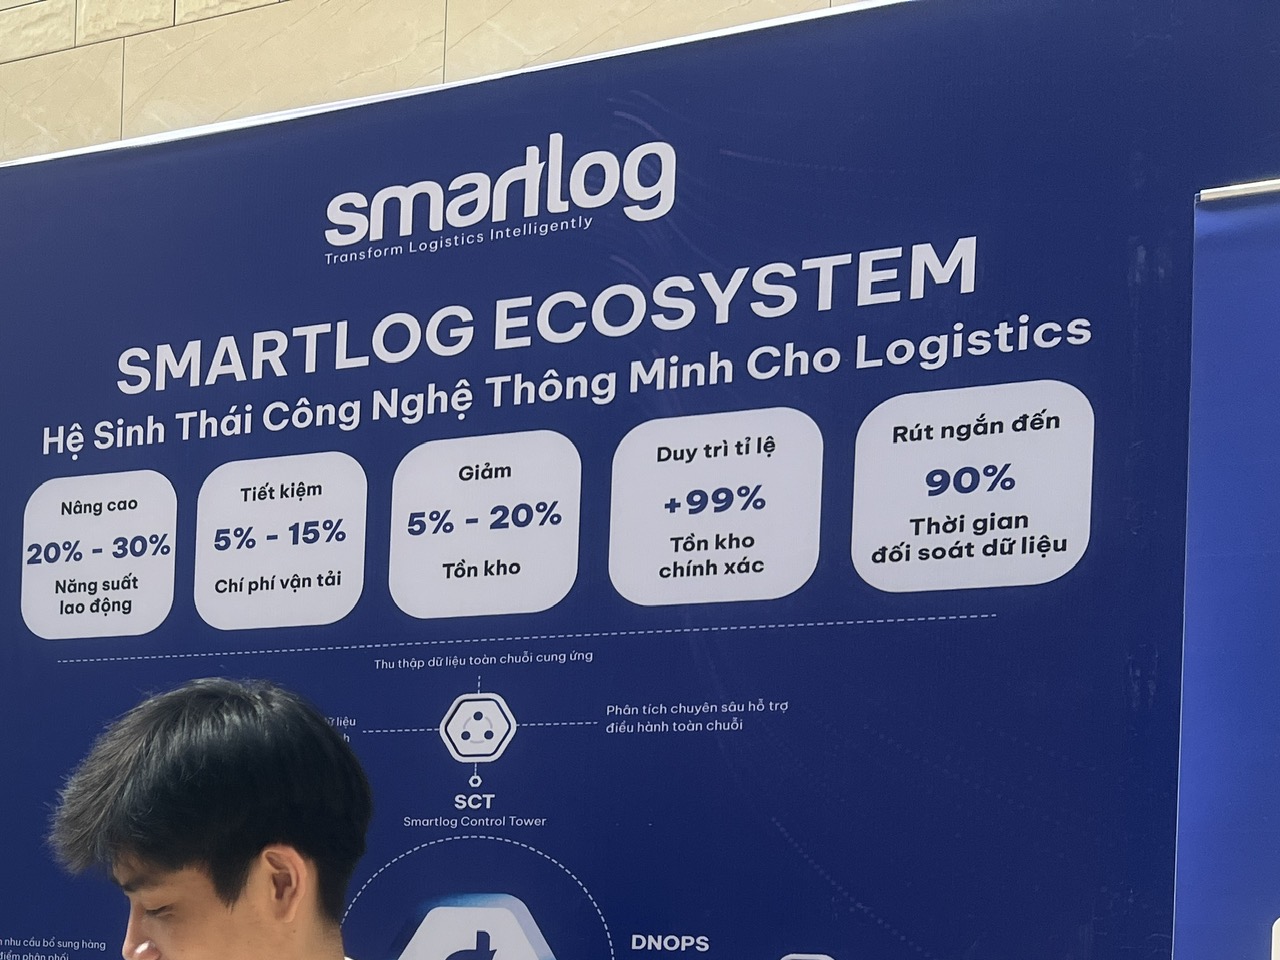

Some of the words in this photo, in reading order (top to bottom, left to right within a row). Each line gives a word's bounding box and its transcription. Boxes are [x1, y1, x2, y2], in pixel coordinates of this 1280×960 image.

[325, 133, 676, 248] smartlog
[325, 246, 403, 264] Transform
[409, 233, 484, 253] Logistics
[490, 216, 593, 240] Intelligently
[117, 306, 474, 394] SMARTLOG
[495, 236, 976, 357] ECOSYSTEM
[43, 423, 84, 460] Hệ
[94, 415, 164, 449] Sinh
[175, 404, 252, 440] Thái
[263, 397, 360, 431] Công
[372, 379, 473, 424] Nghệ
[485, 369, 616, 407] Thông
[630, 351, 733, 393] Minh
[747, 342, 840, 379] Cho
[856, 314, 1091, 370] Logistics
[893, 423, 934, 443] Rút
[941, 413, 1004, 441] ngắn
[1012, 409, 1060, 432] đến
[657, 447, 698, 464] Duy
[703, 439, 728, 458] trì
[735, 436, 751, 455] tỉ
[757, 436, 775, 458] lệ
[459, 462, 511, 481] Giảm
[926, 463, 1015, 496] 90%
[240, 482, 275, 502] Tiết
[280, 481, 322, 502] kiệm
[664, 485, 766, 515] +99%
[61, 500, 102, 516] Nâng
[107, 499, 138, 511] cao
[407, 509, 454, 536] 5%
[490, 501, 562, 530] 20%
[214, 526, 256, 551] 5%
[288, 518, 346, 545] 15%
[909, 514, 965, 536] Thời
[973, 512, 1028, 536] gian
[27, 540, 83, 565] 20%
[112, 533, 170, 558] 30%
[670, 533, 708, 552] Tồn
[715, 533, 755, 550] kho
[871, 541, 911, 563] đối
[918, 540, 974, 561] soát
[1021, 535, 1067, 558] liệu
[442, 559, 478, 579] Tồn
[484, 559, 521, 576] kho
[659, 559, 717, 578] chính
[724, 556, 764, 575] xác
[55, 579, 97, 595] Năng
[102, 572, 138, 591] suất
[215, 577, 244, 593] Chí
[248, 575, 276, 595] phí
[280, 574, 311, 593] vận
[316, 570, 341, 587] tải
[60, 600, 85, 615] lao
[90, 597, 132, 617] động
[374, 659, 395, 669] Thu
[398, 658, 425, 669] thập
[445, 655, 466, 668] liệu
[469, 654, 496, 665] toàn
[536, 652, 566, 665] cung
[607, 704, 638, 716] Phân
[642, 704, 667, 715] tích
[670, 702, 717, 716] chuyên
[721, 701, 744, 712] sâu
[769, 701, 788, 713] trợ
[637, 721, 669, 732] hành
[673, 720, 703, 732] toàn
[454, 794, 495, 809] SCT
[404, 816, 458, 829] Smartlog
[461, 816, 505, 826] Control
[509, 816, 547, 826] Tower
[4, 937, 21, 946] nhu
[57, 941, 80, 950] sung
[82, 939, 106, 951] hàng
[632, 934, 709, 951] DNOPS
